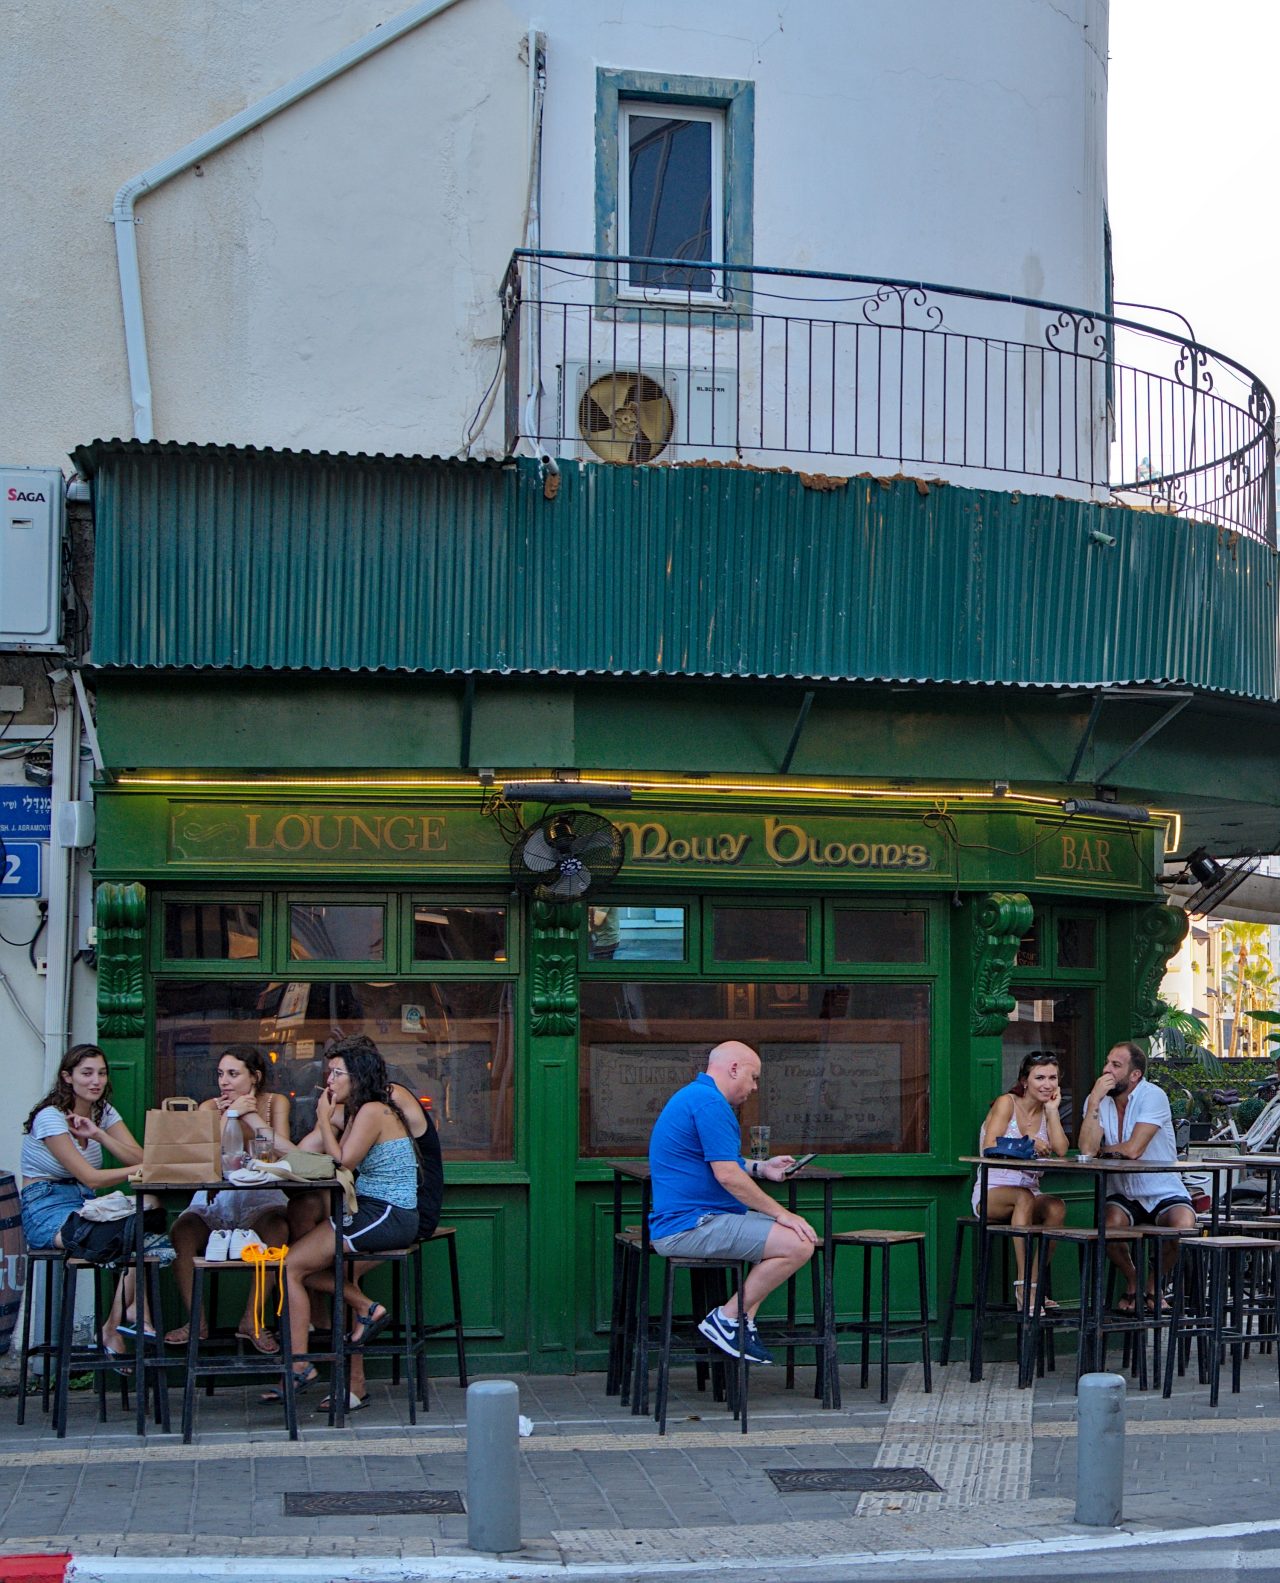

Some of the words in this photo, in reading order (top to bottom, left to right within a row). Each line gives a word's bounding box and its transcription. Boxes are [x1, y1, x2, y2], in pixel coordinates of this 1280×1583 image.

[8, 488, 46, 502] SAGA
[246, 813, 447, 851] LOUNGE
[1061, 835, 1113, 872] BAR
